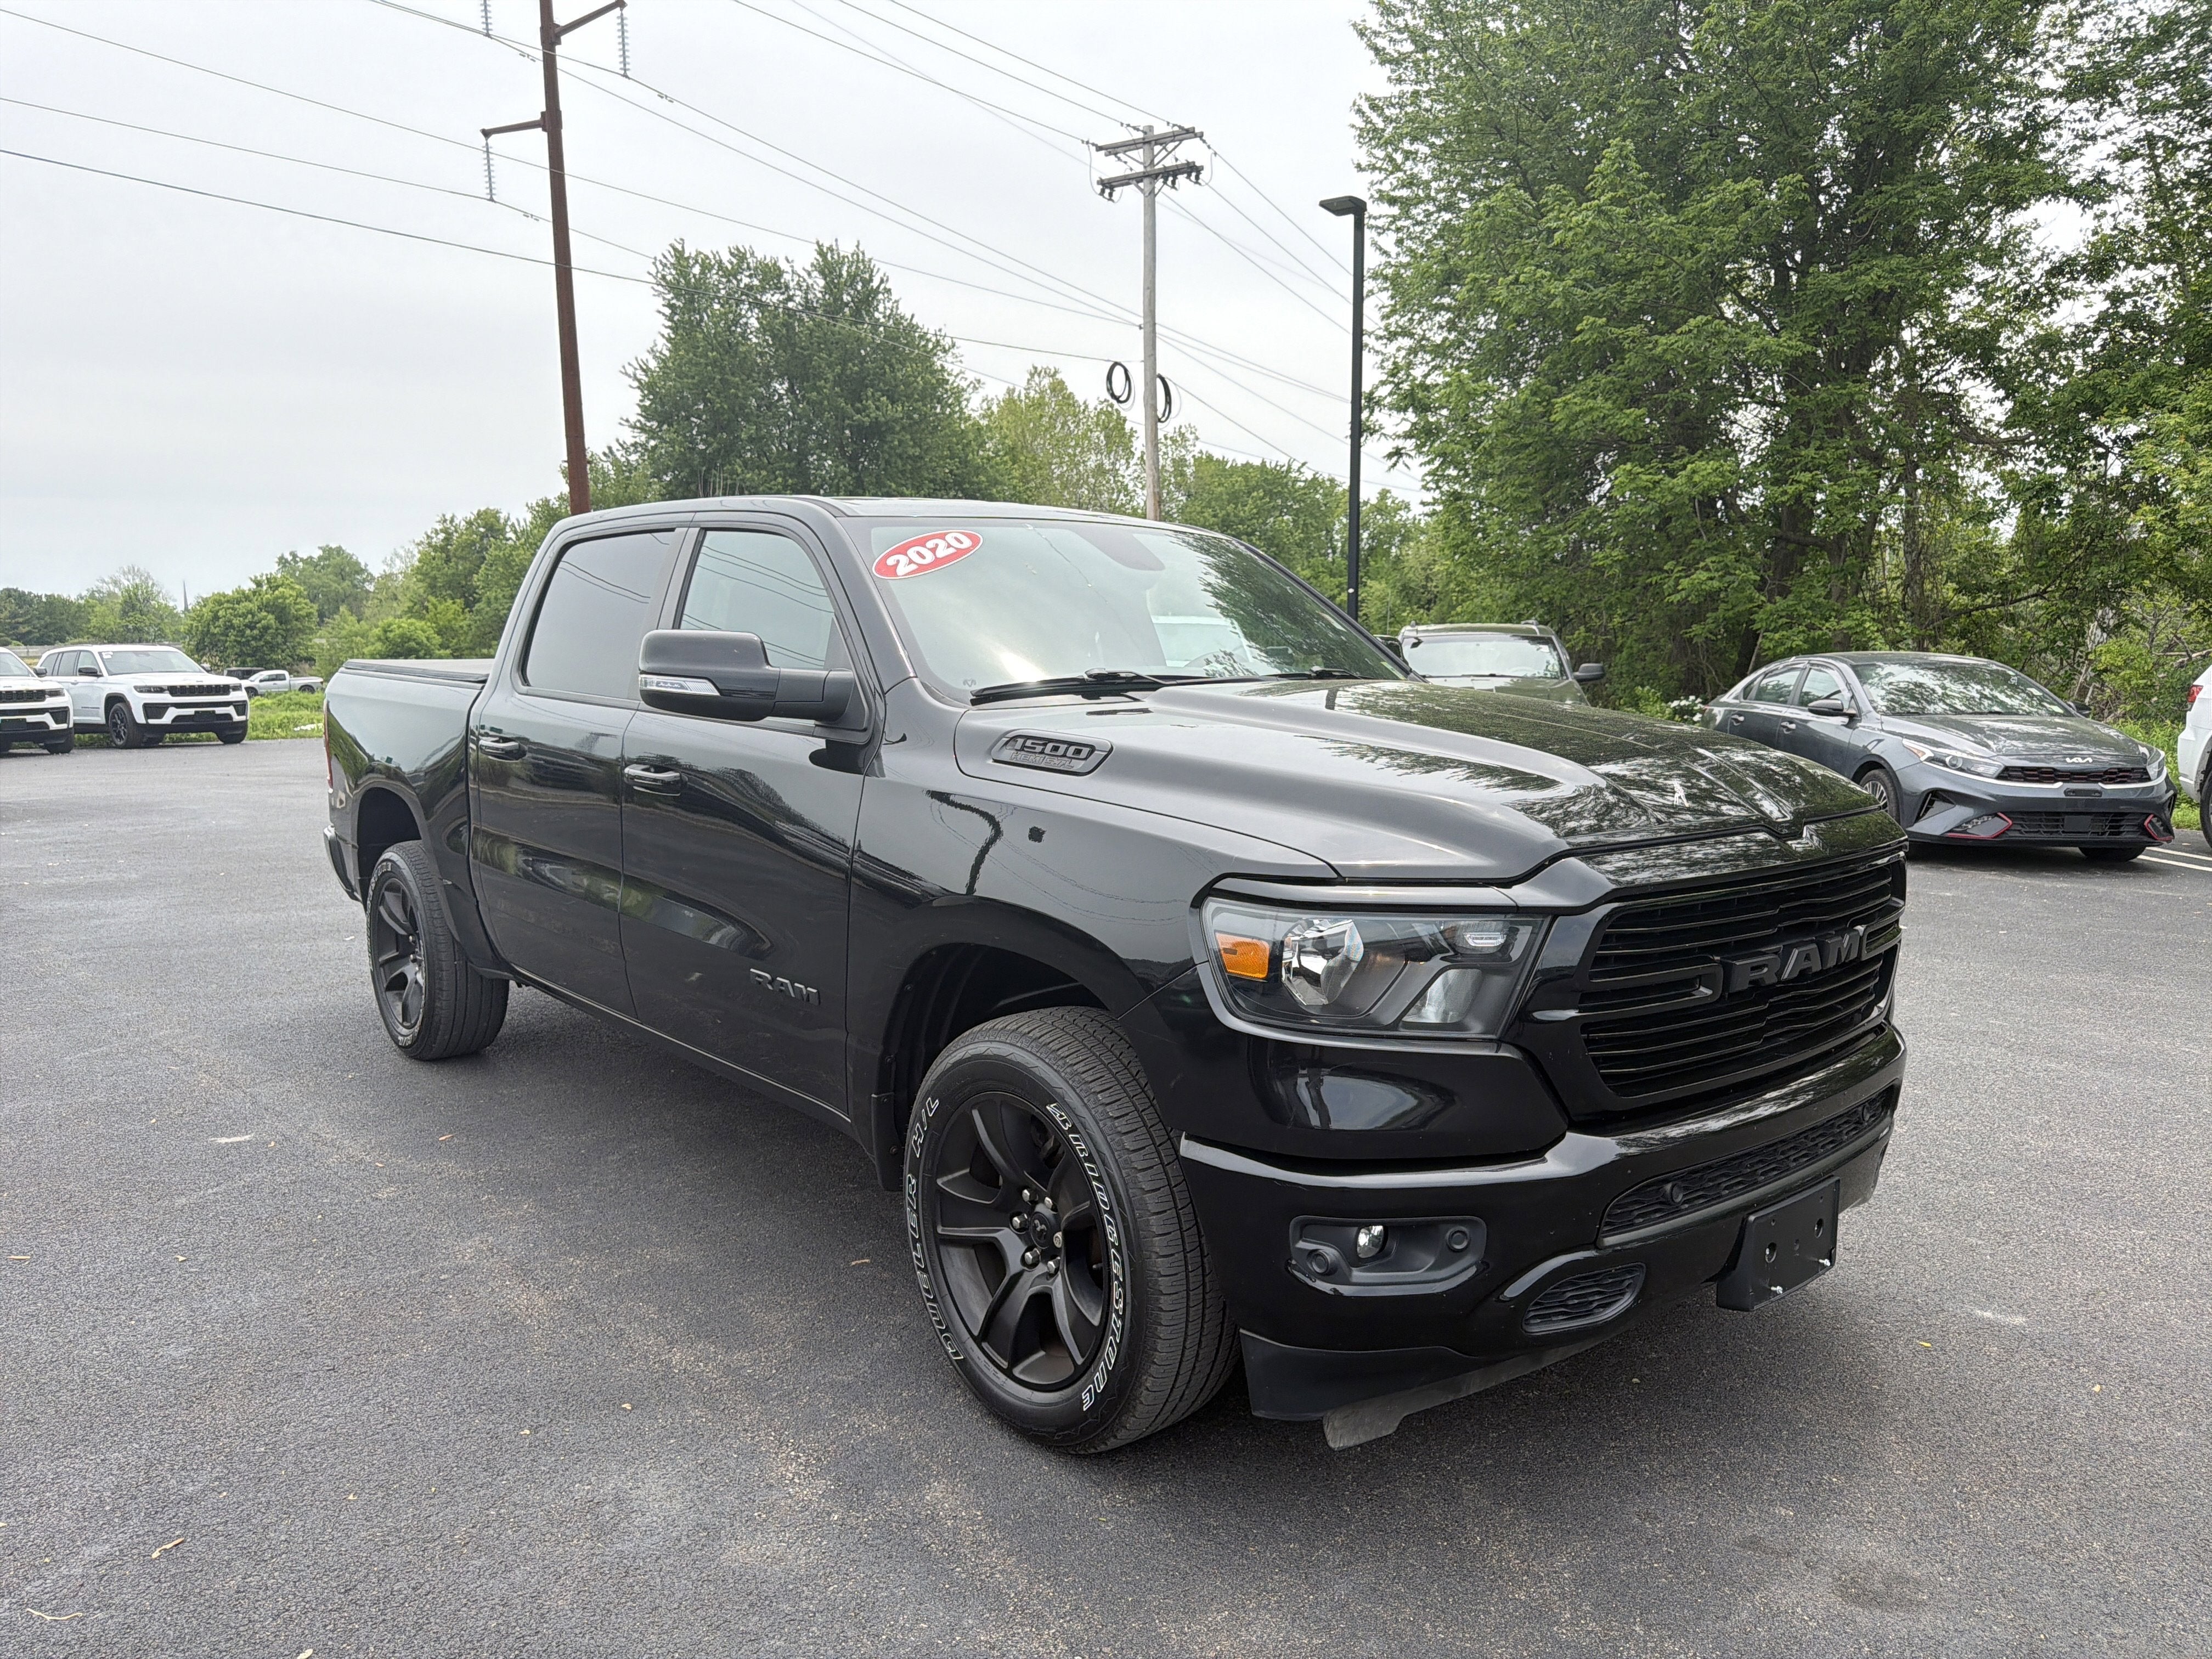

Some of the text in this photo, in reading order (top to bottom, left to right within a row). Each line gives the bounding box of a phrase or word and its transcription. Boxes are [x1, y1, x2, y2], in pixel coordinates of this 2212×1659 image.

[886, 532, 973, 576] 2020
[1010, 752, 1075, 769] HEMI 5.7L
[1013, 737, 1092, 759] 1500
[1720, 928, 1861, 994] RAM
[749, 968, 821, 1006] RAM
[906, 1173, 965, 1361] DUELER
[1046, 1102, 1124, 1412] BRIDGESTONE
